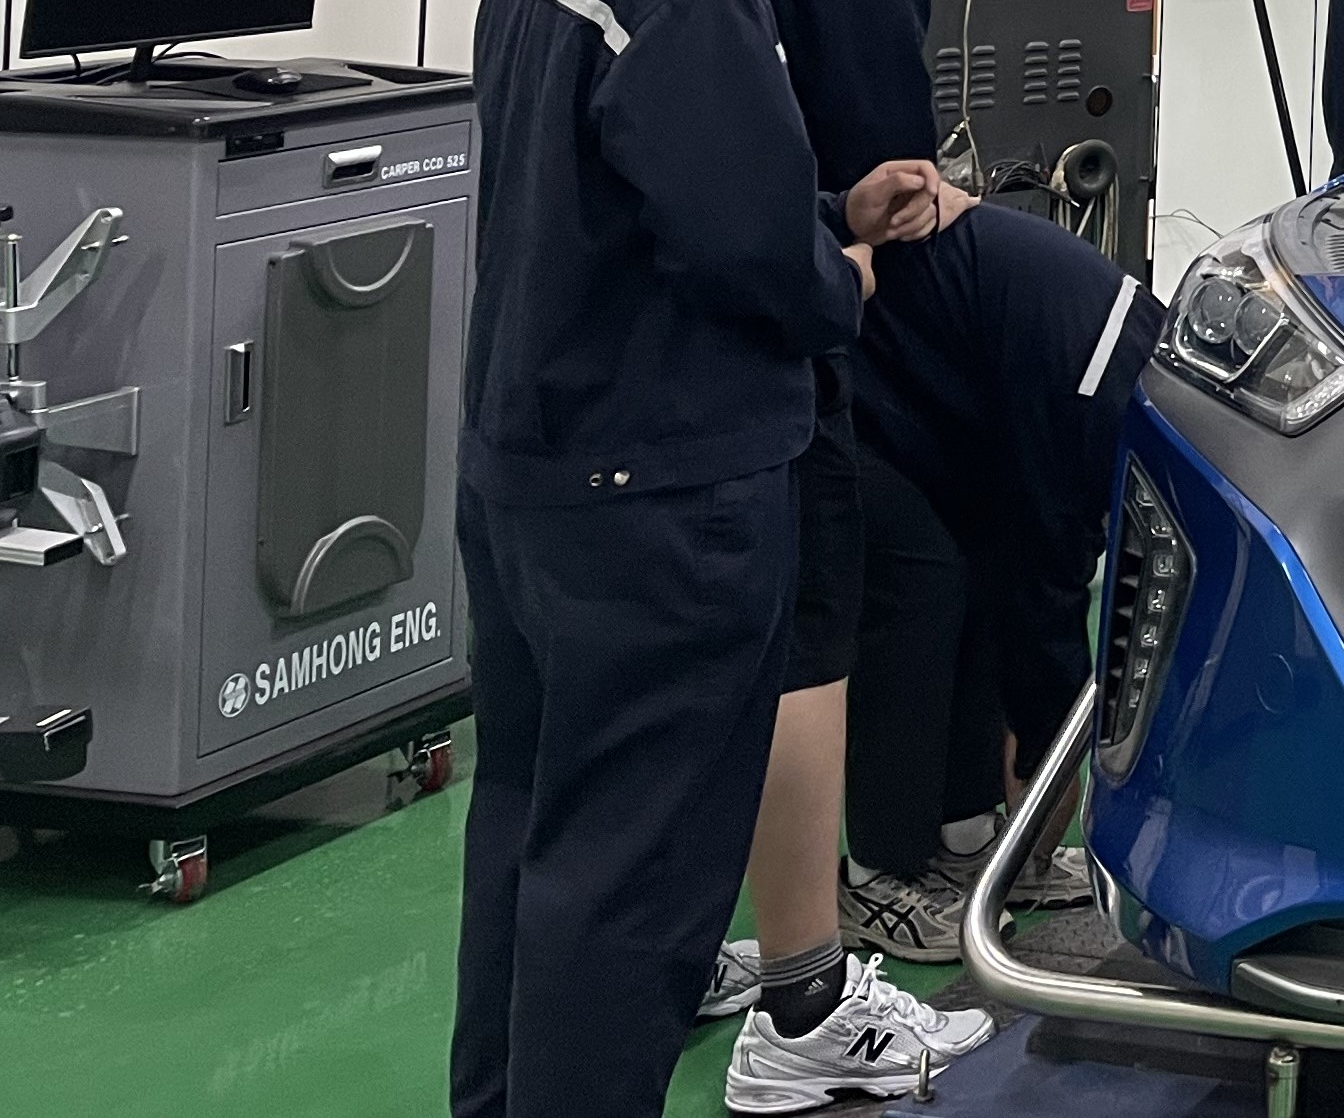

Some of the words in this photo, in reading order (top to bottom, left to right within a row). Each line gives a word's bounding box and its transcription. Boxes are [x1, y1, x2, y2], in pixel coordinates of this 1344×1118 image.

[422, 156, 444, 171] CCD
[446, 153, 465, 168] 525
[254, 621, 381, 705] SAMHONG
[390, 601, 441, 653] ENG.
[844, 1026, 896, 1064] N
